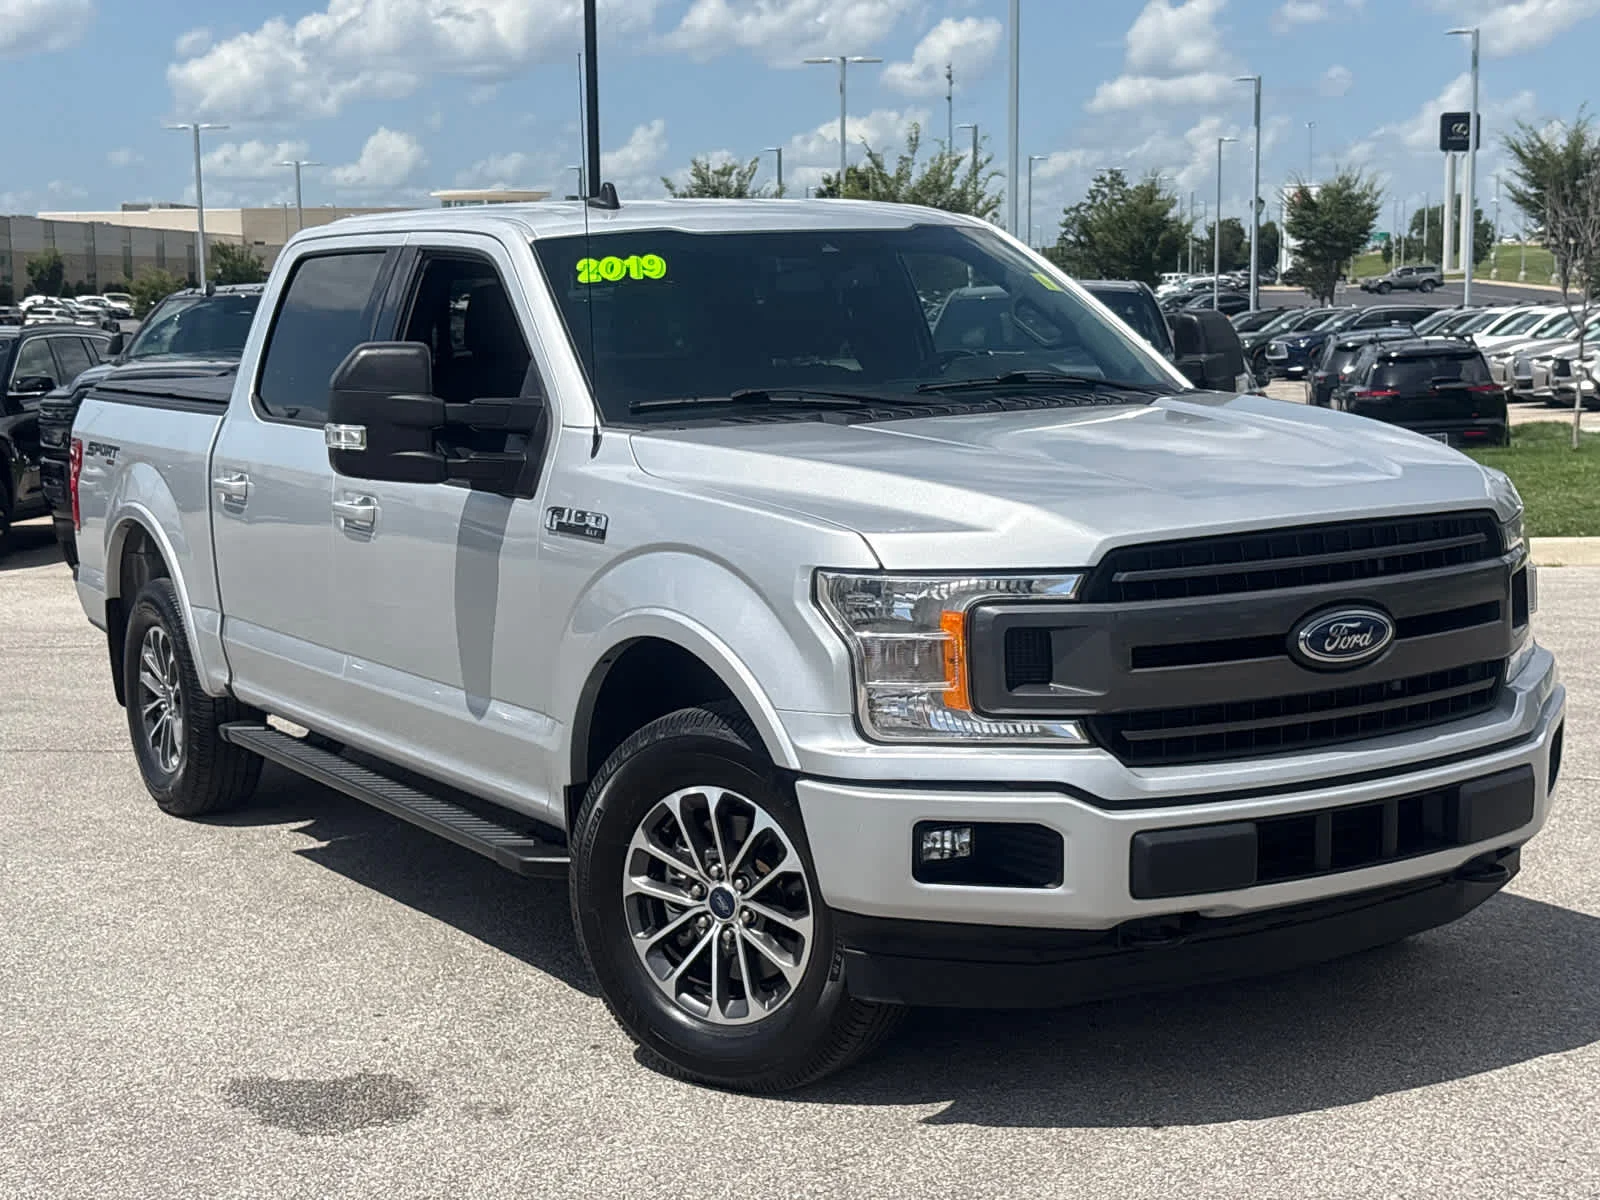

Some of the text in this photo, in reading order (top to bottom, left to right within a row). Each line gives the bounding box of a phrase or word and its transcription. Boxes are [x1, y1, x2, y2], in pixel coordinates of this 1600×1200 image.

[576, 254, 667, 283] 2019
[85, 441, 121, 458] SPORT
[1324, 621, 1374, 652] Ford
